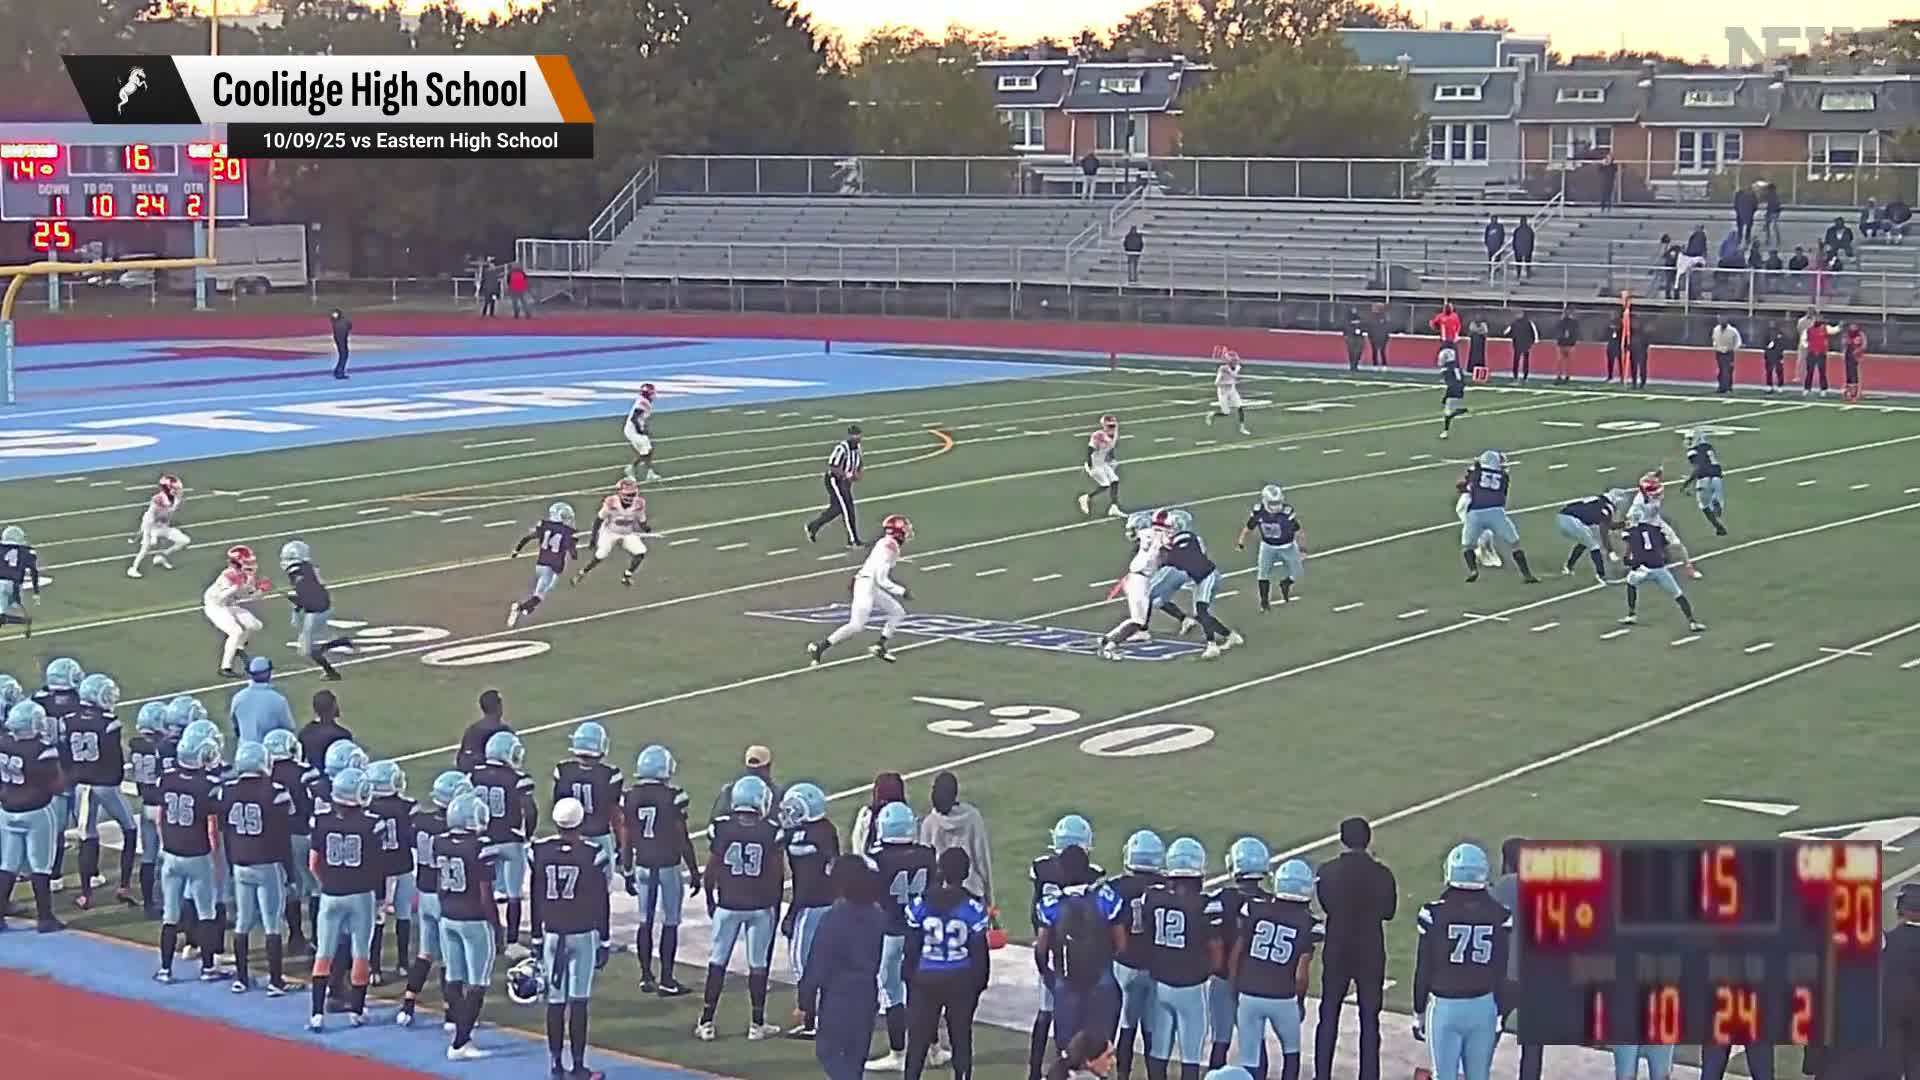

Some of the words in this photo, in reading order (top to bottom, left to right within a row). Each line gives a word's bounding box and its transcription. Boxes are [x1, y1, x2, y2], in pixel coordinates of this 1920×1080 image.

[13, 161, 35, 181] 14
[125, 145, 151, 170] 16
[212, 158, 241, 180] 20
[91, 196, 114, 217] 10
[135, 195, 166, 217] 24
[187, 195, 201, 217] 2
[33, 221, 71, 248] 25
[541, 530, 563, 553] 14
[638, 806, 657, 838] 7
[723, 841, 763, 877] 43
[545, 864, 580, 900] 17
[922, 916, 969, 961] 22
[1153, 907, 1185, 948] 12
[1250, 919, 1298, 965] 25
[1447, 924, 1494, 965] 75
